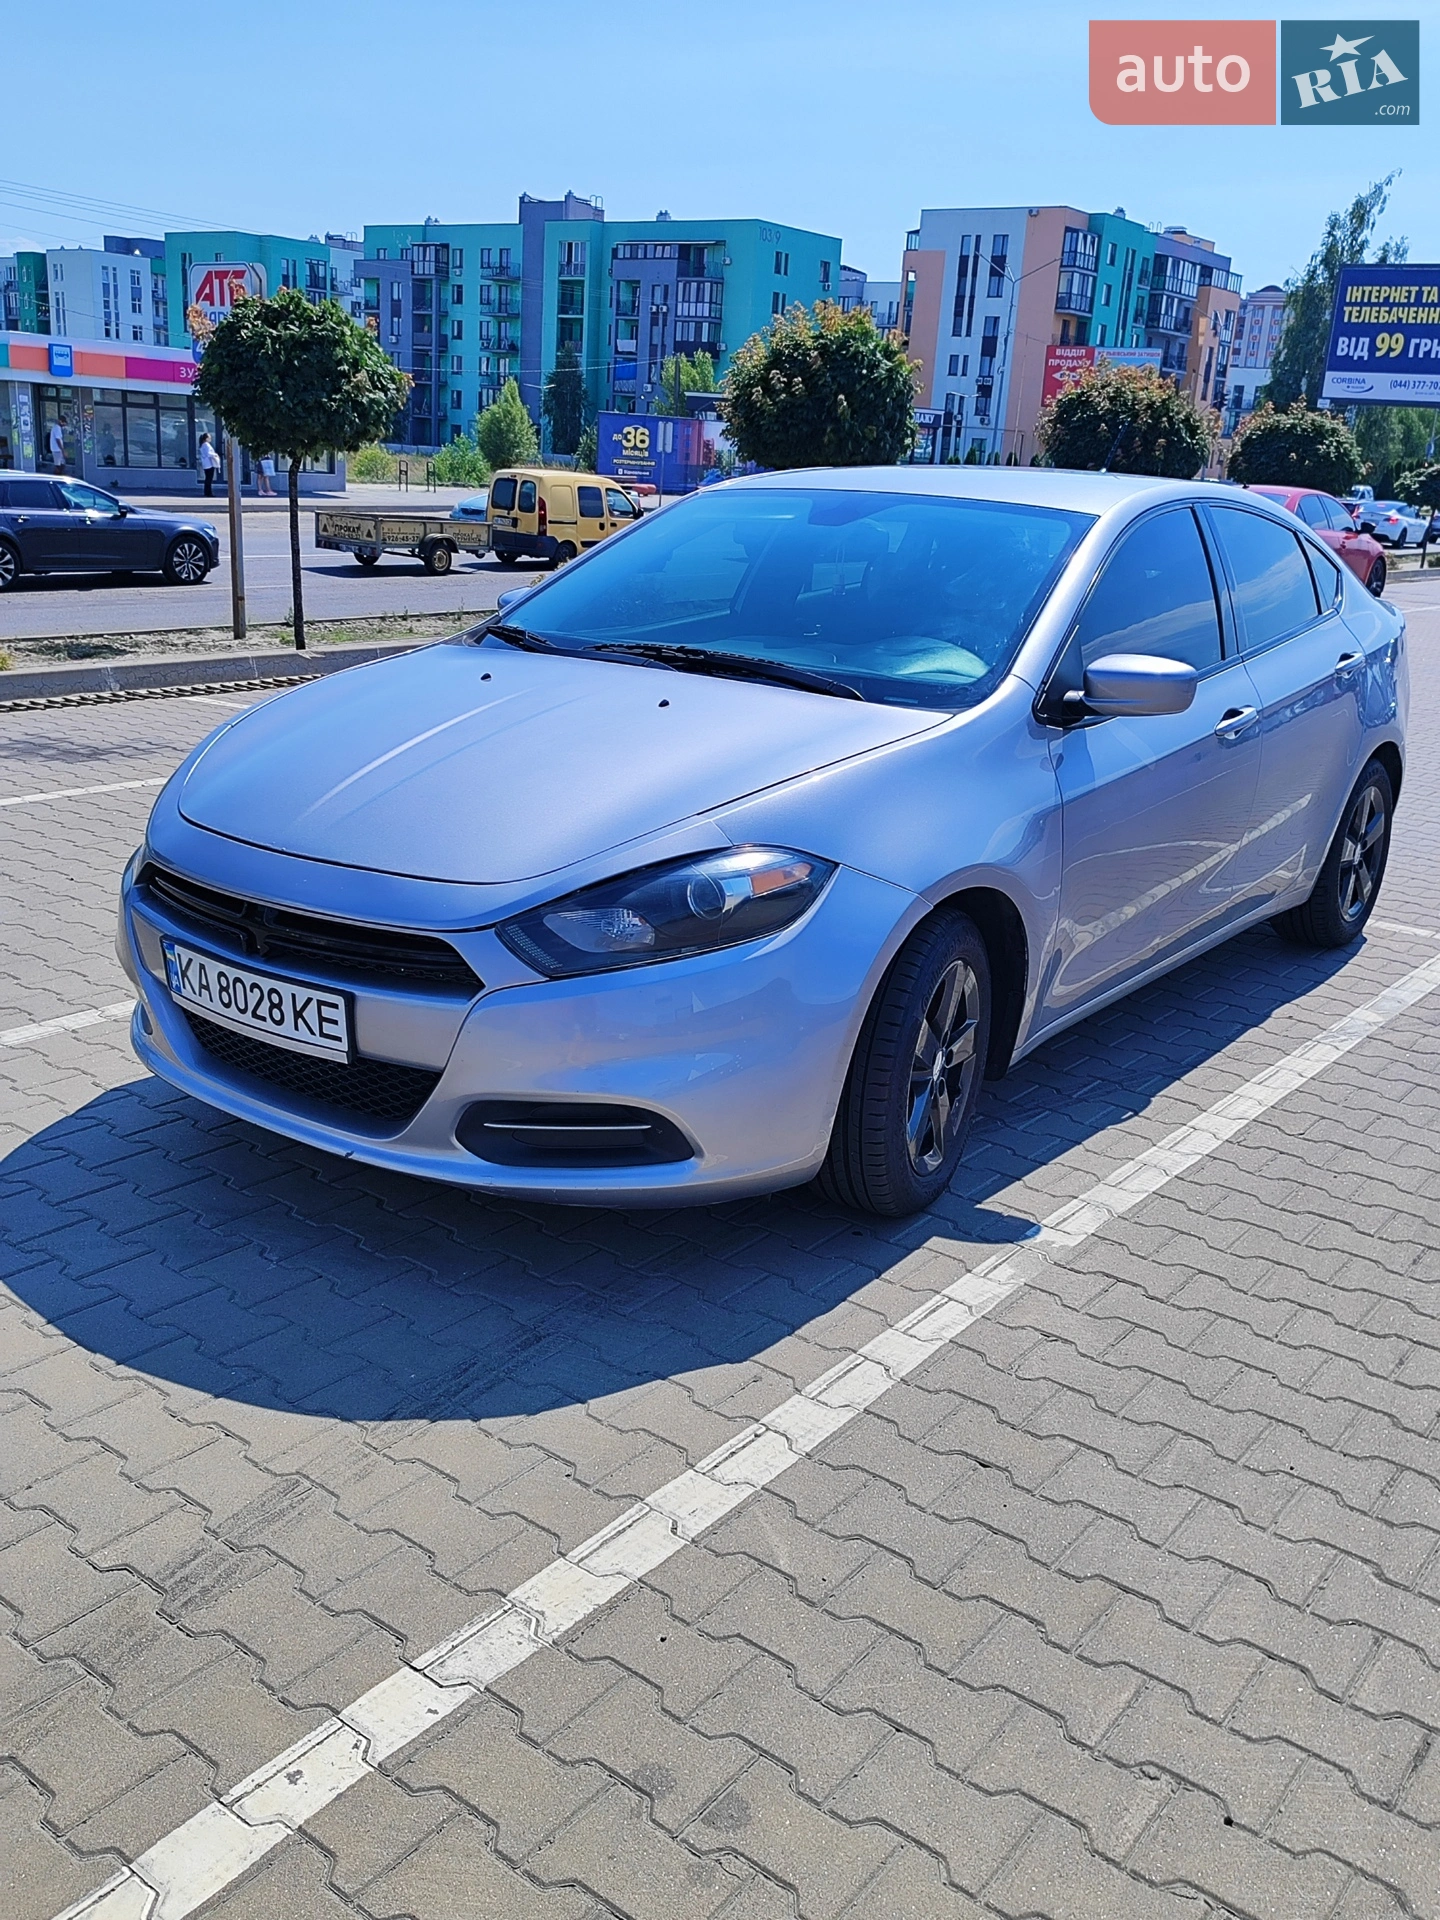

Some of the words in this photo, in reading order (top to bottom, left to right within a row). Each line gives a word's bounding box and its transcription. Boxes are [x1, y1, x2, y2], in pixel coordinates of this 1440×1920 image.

[1345, 285, 1420, 303] ІНТЕРНЕТ
[1421, 286, 1439, 303] ТА
[1343, 306, 1440, 324] ТЕЛЕБАЧЕНН
[1055, 348, 1086, 357] ВІДДІЛ
[1336, 336, 1370, 361] ВІД
[1375, 332, 1405, 358] 99
[1331, 377, 1366, 385] CORBINA
[1389, 379, 1411, 391] (044)
[621, 426, 650, 449] 36
[334, 523, 361, 534] ПРОКАТ
[177, 952, 213, 1003] KA
[216, 971, 285, 1026] 8028
[290, 992, 343, 1043] KE
